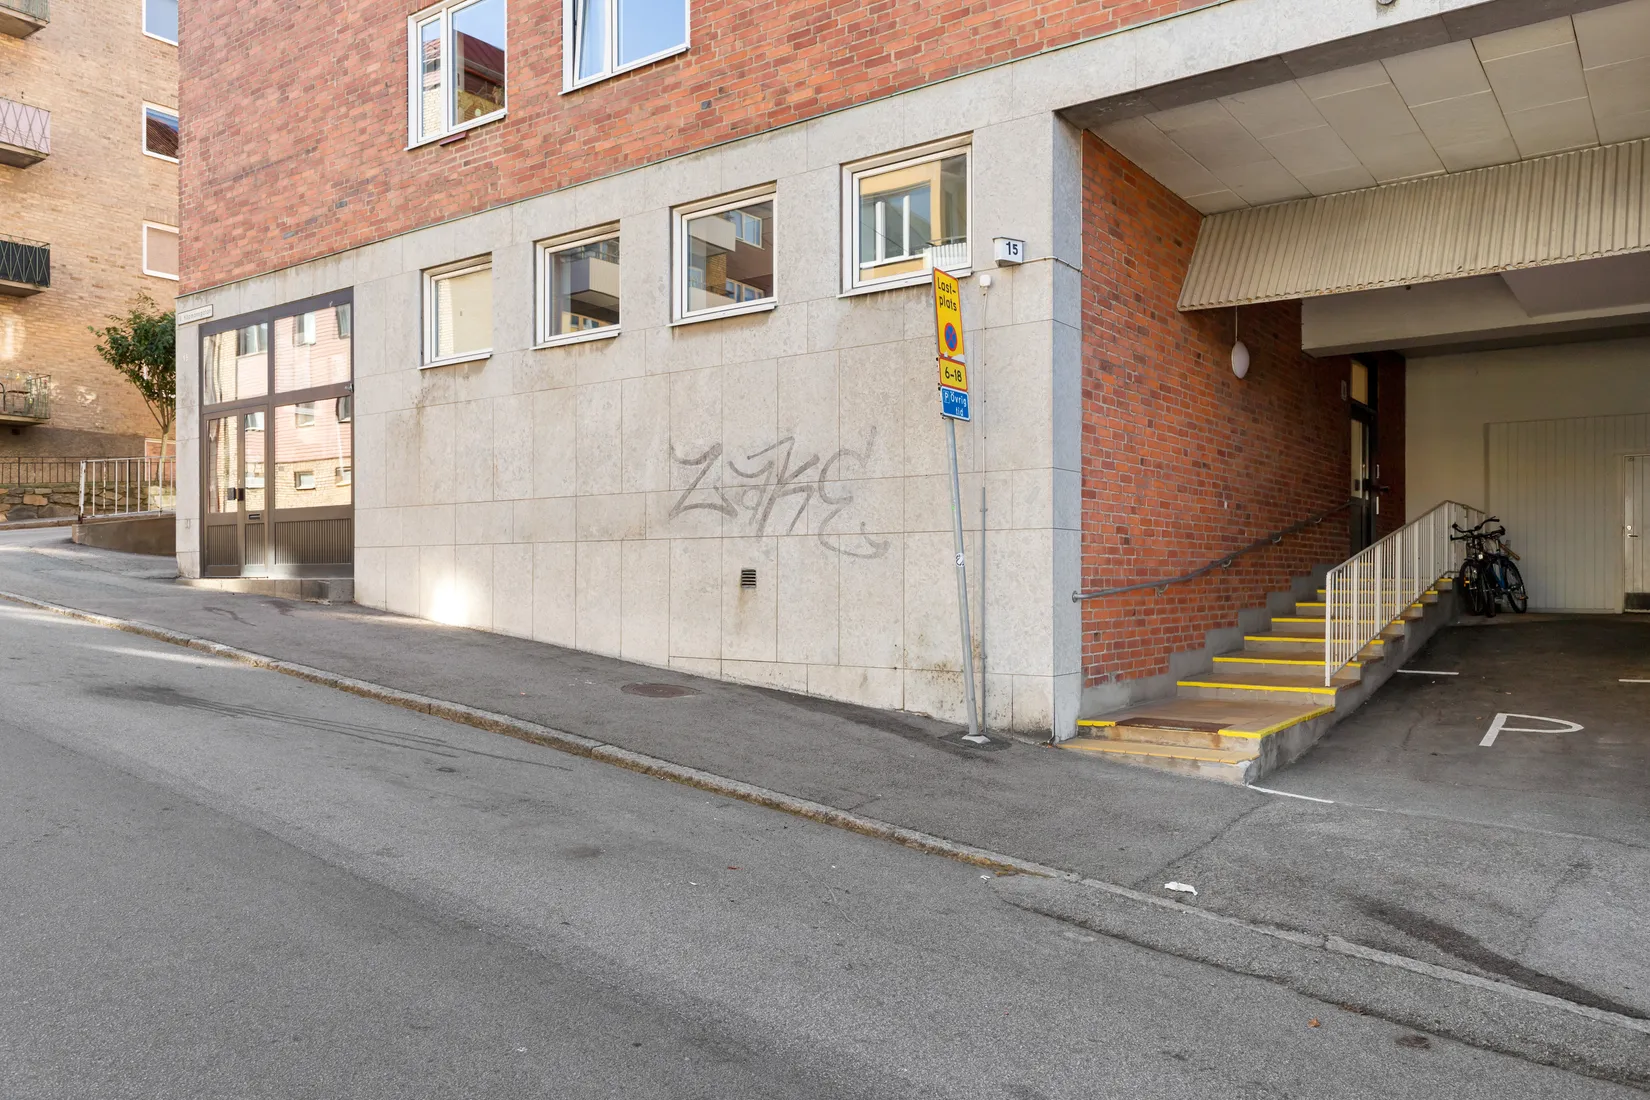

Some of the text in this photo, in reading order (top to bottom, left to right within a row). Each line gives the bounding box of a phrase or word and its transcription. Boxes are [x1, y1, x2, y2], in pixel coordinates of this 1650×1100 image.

[1005, 241, 1019, 256] 15
[937, 276, 957, 295] Last-
[938, 294, 958, 312] plats
[944, 366, 963, 383] 6-18
[950, 391, 967, 408] Övrig
[955, 406, 964, 417] tid
[1478, 712, 1585, 747] P
